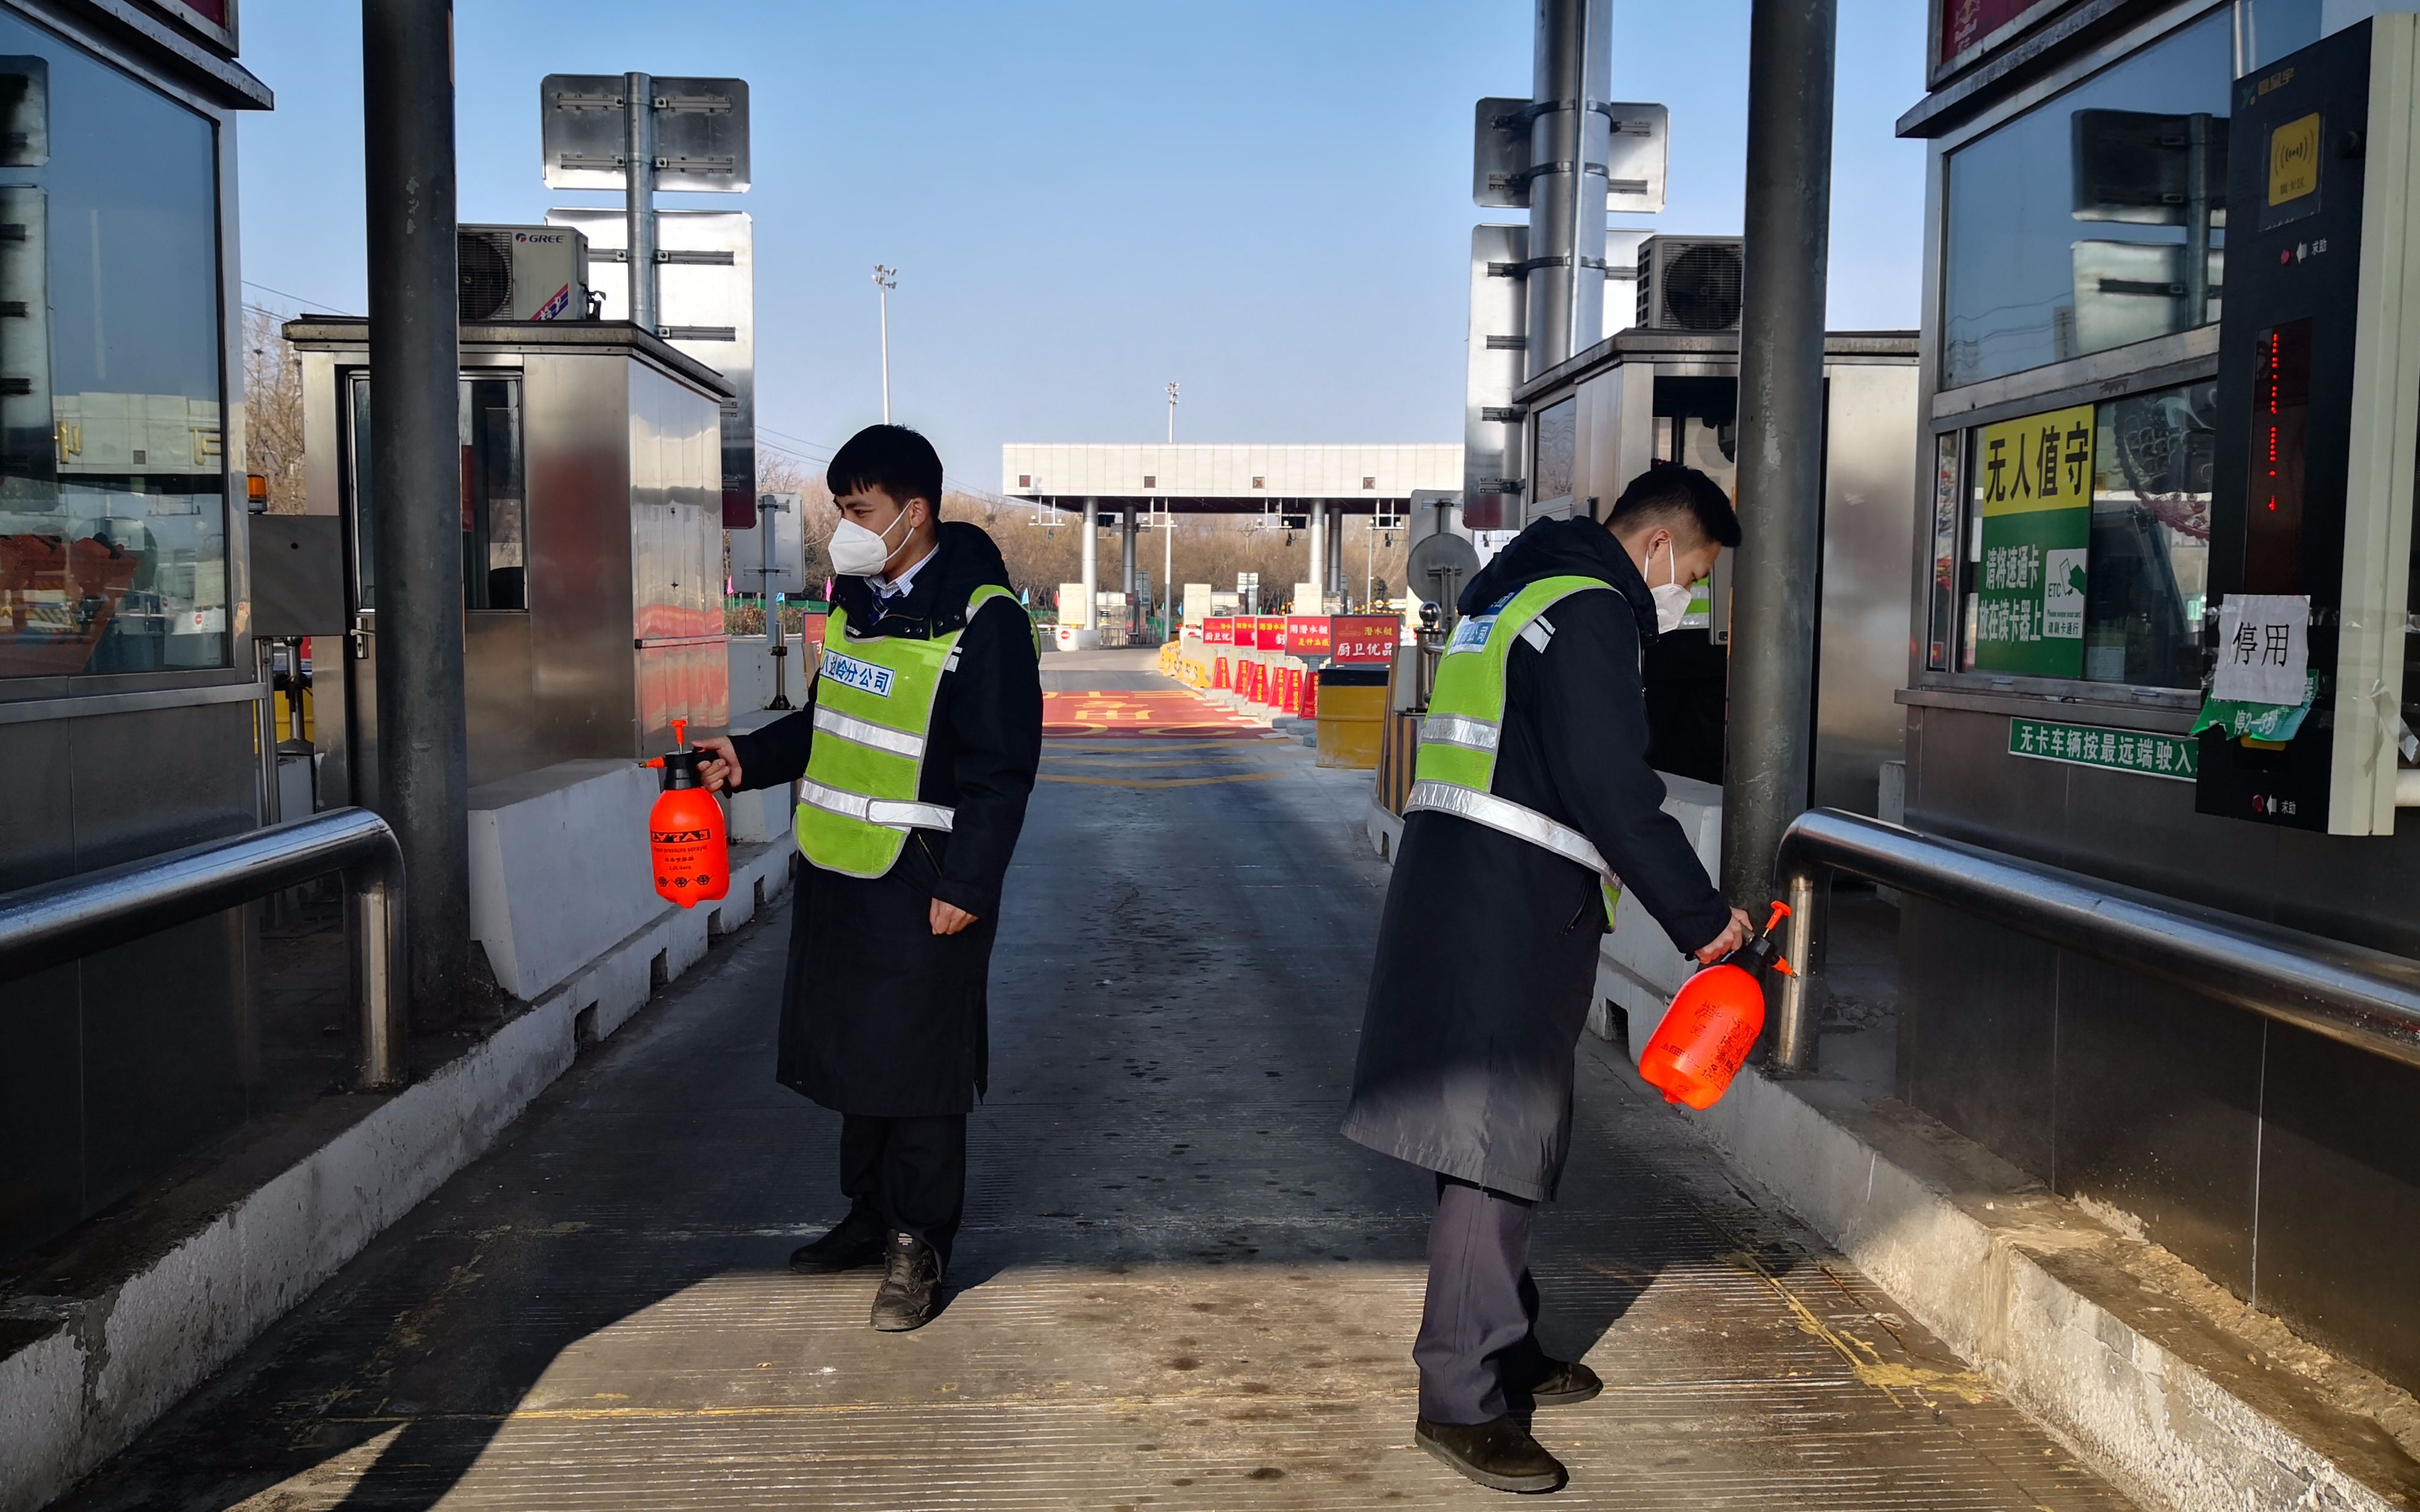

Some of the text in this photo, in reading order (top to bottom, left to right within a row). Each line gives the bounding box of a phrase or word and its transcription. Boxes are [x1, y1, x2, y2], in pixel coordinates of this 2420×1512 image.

[529, 235, 564, 243] GREE
[2311, 238, 2327, 256] 求助
[1986, 421, 2089, 504] 无人值守
[1986, 544, 2039, 590] 请将速通卡
[2048, 583, 2061, 597] ETC
[1978, 598, 2041, 642] 放在读卡器上
[1290, 624, 1328, 635] 用潜水艇
[1364, 627, 1393, 636] 潜水艇
[2048, 622, 2078, 635] 请刷卡通行
[1337, 642, 1393, 657] 厨卫优品
[2232, 622, 2289, 667] 停用
[2020, 726, 2199, 774] 无卡车辆按最远端驶入
[2281, 800, 2296, 815] 求助
